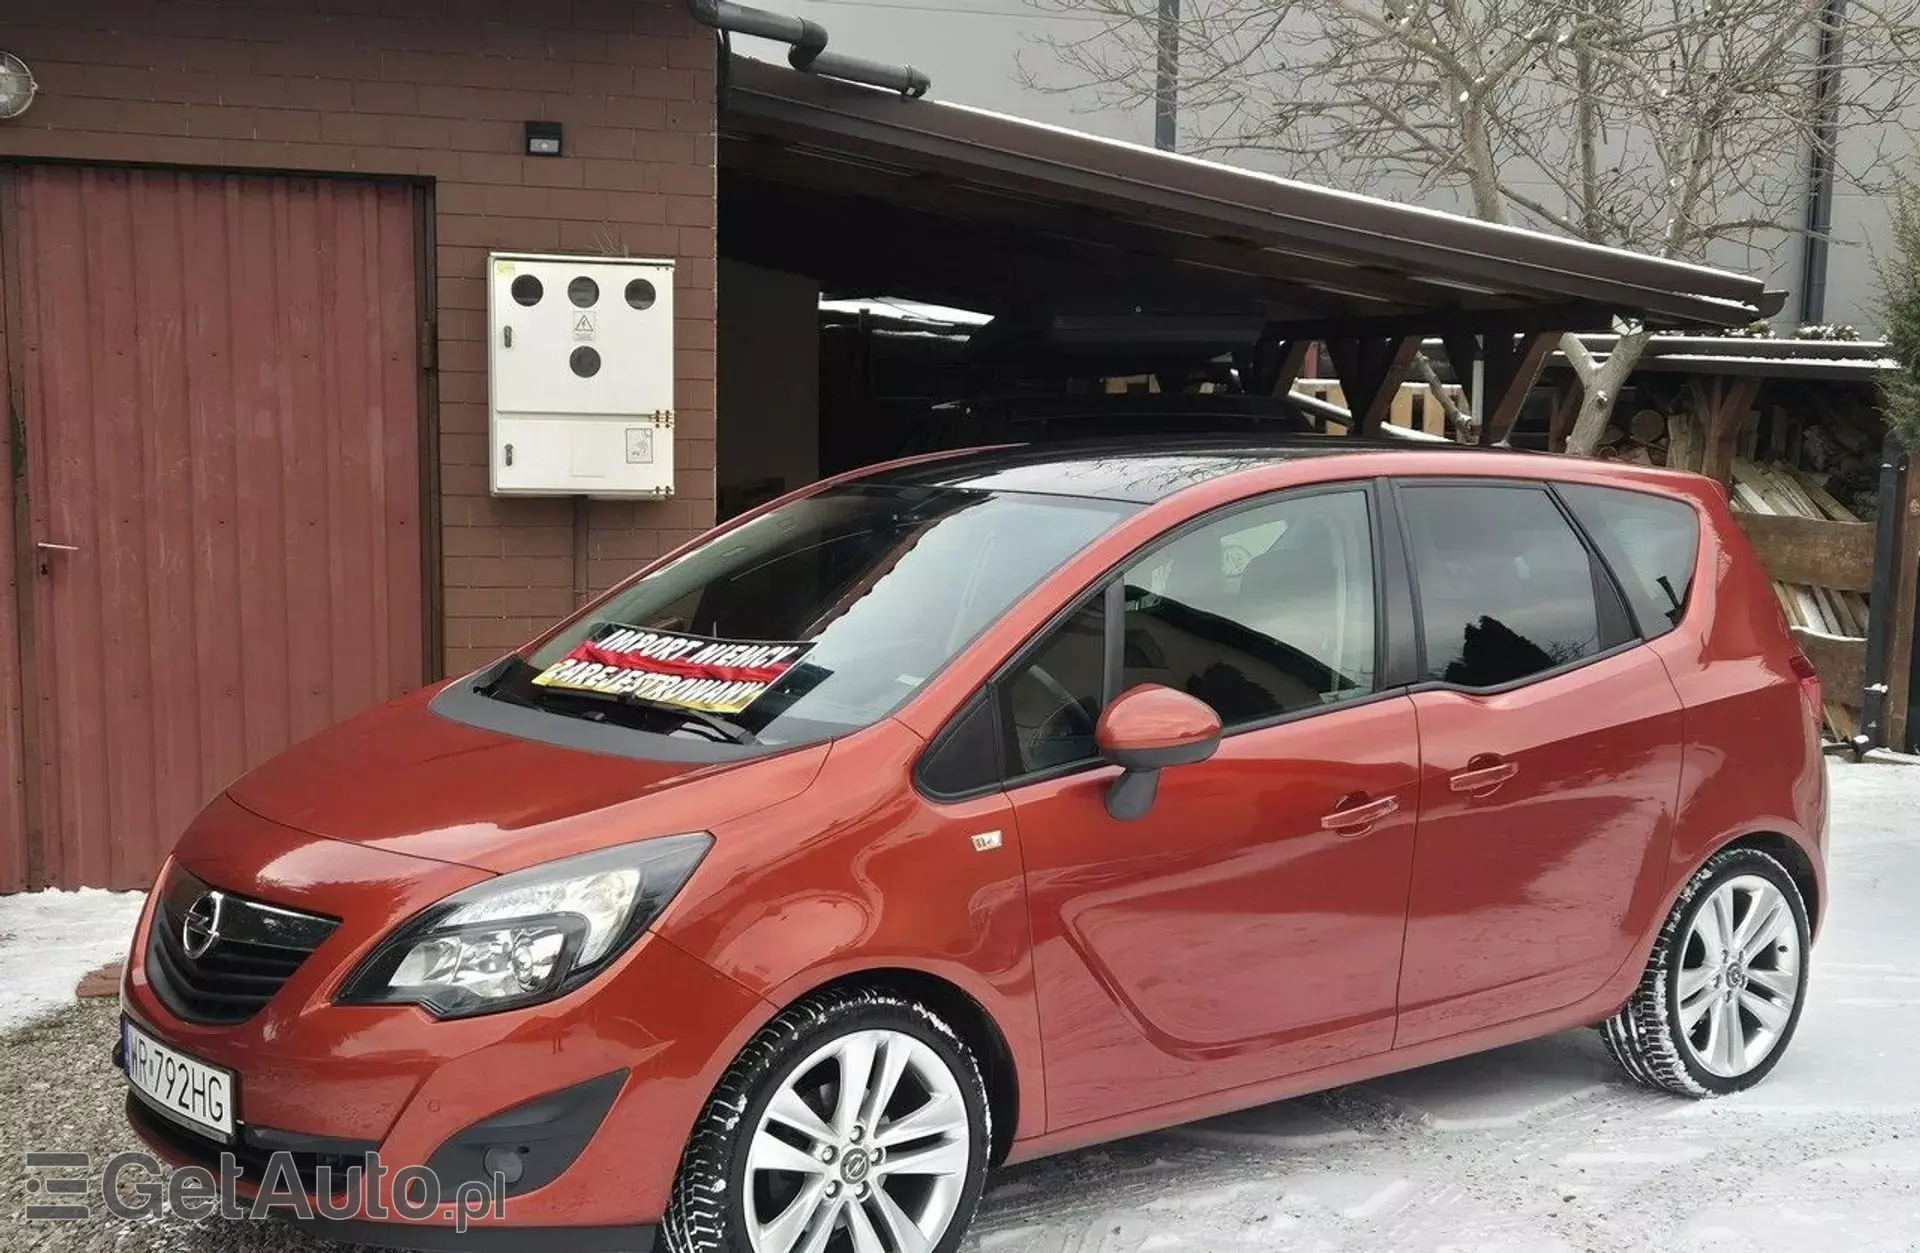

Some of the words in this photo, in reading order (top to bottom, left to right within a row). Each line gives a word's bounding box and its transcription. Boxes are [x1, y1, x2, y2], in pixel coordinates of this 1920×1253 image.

[594, 628, 705, 661] IMPORT
[685, 643, 799, 669] NIEMCY
[546, 658, 766, 705] ZAREJESTROWANY
[154, 1048, 224, 1123] 792HG
